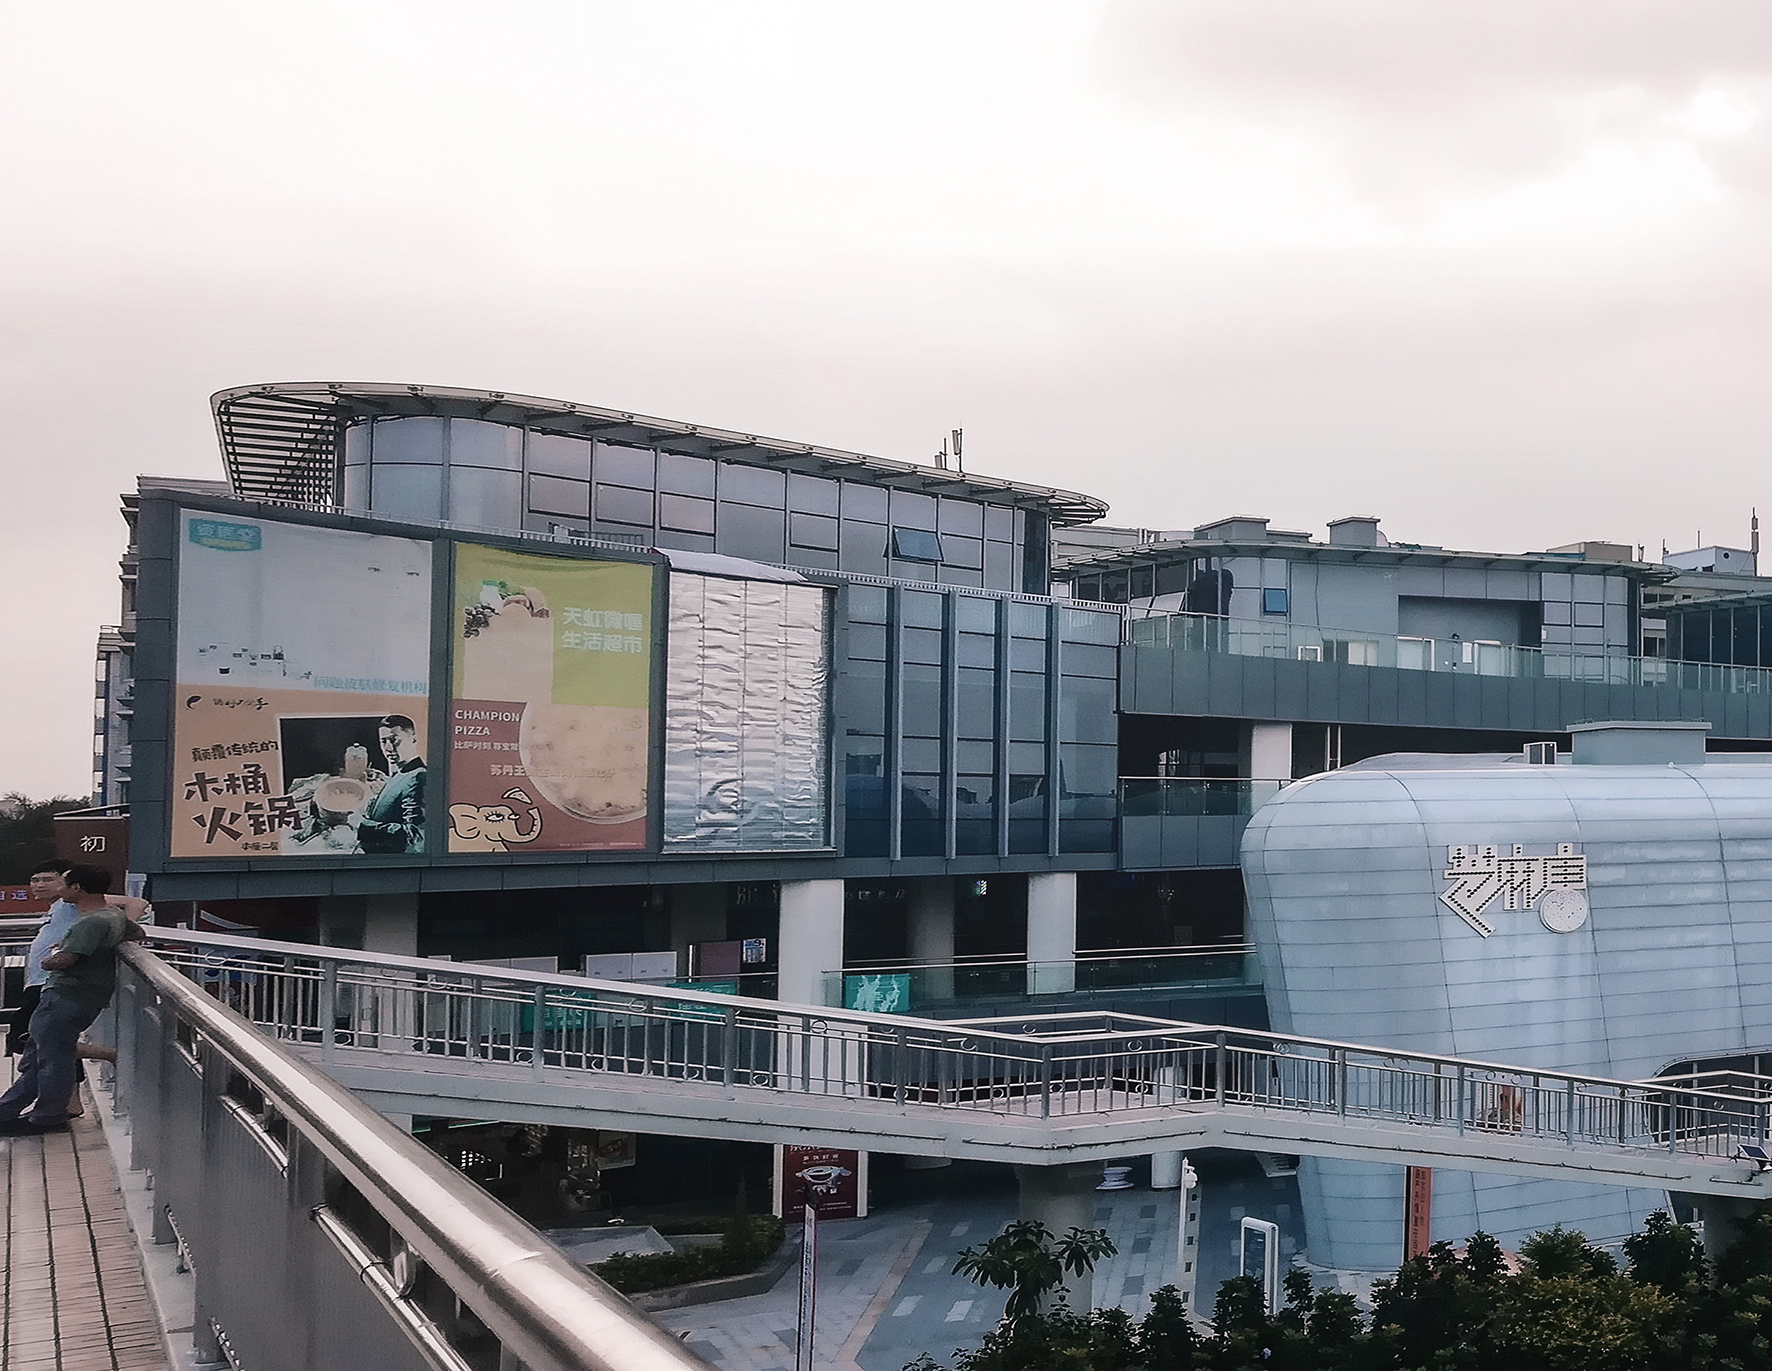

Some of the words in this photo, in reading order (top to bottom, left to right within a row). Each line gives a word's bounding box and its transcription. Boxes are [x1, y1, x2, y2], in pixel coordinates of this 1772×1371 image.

[561, 630, 643, 653] 生活超市
[312, 676, 427, 695] 问题皮肤修复机构
[454, 708, 520, 723] CHAMPION
[454, 725, 491, 736] PIZZA
[191, 740, 279, 762] 颠覆传统的
[184, 763, 271, 803] 木桶
[192, 795, 303, 845] 火锅
